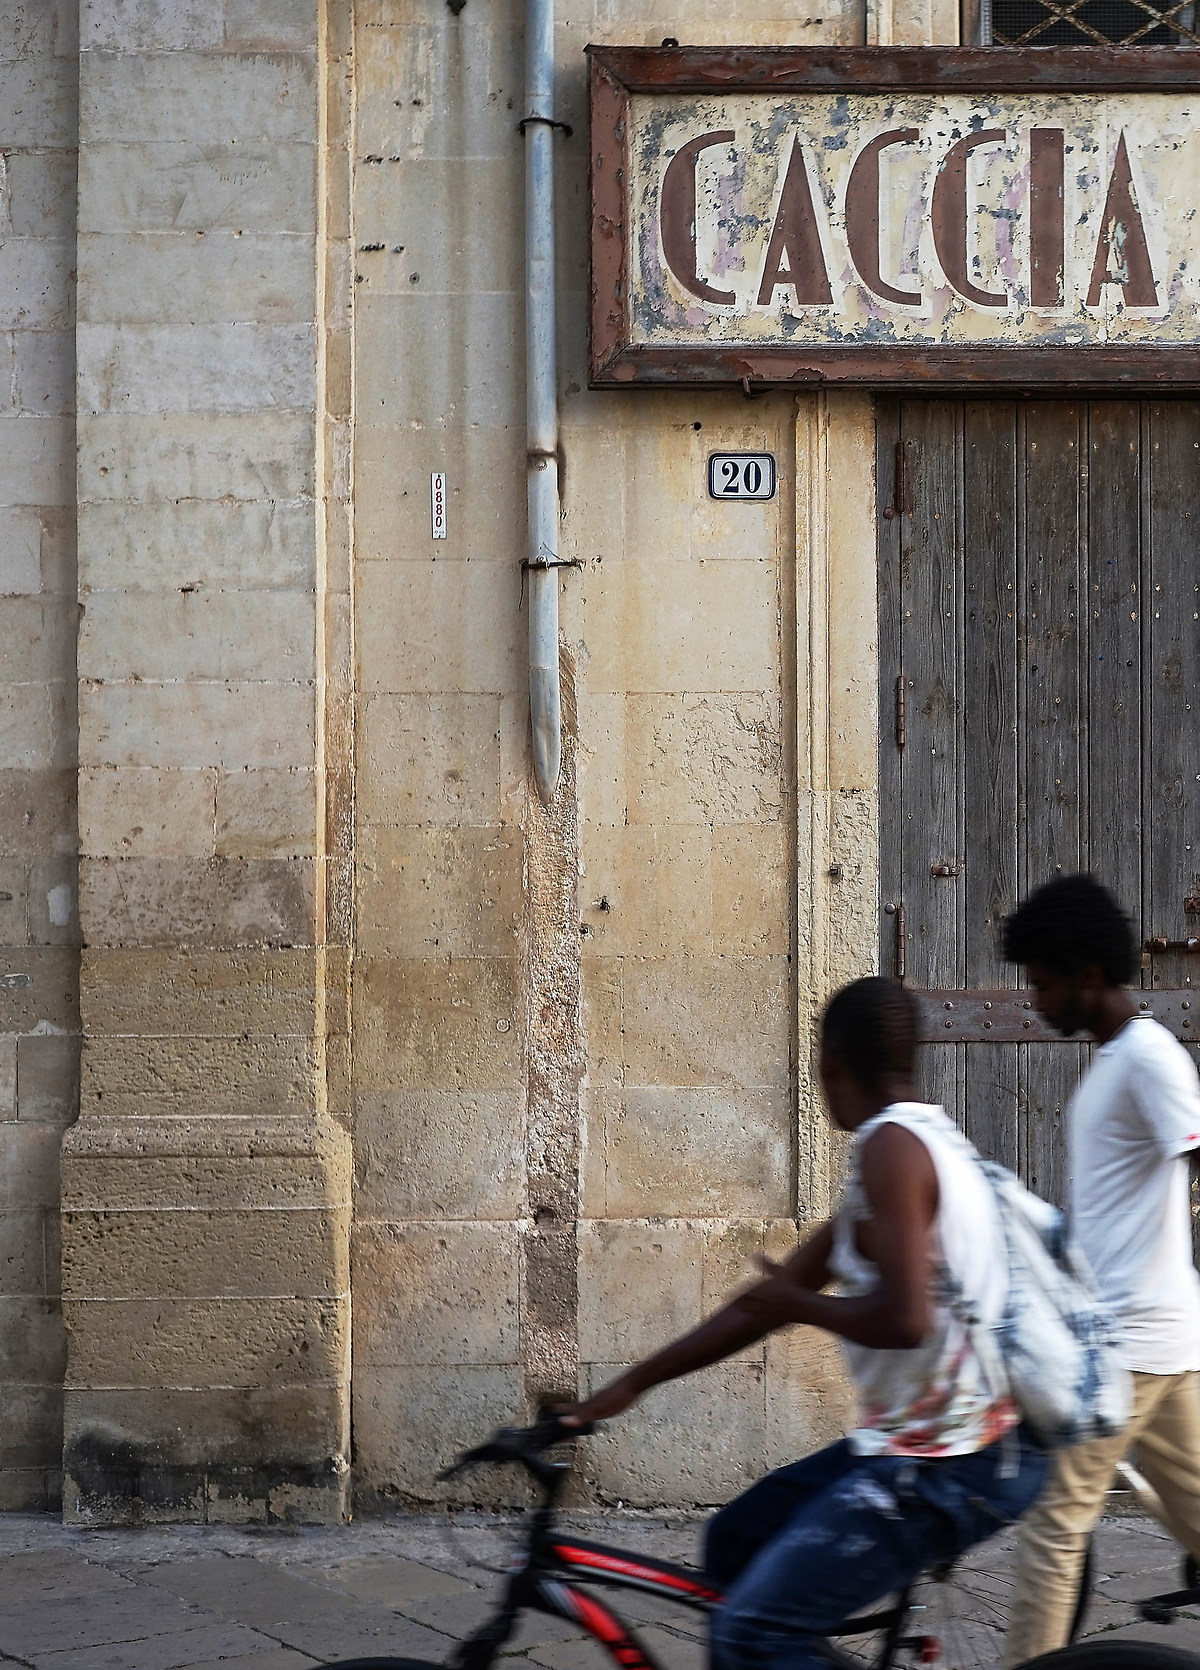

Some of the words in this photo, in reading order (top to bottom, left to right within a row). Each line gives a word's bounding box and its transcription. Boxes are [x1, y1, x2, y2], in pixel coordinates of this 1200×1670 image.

[660, 127, 1160, 307] CACCIA
[721, 461, 762, 493] 20
[435, 478, 443, 527] 0880
